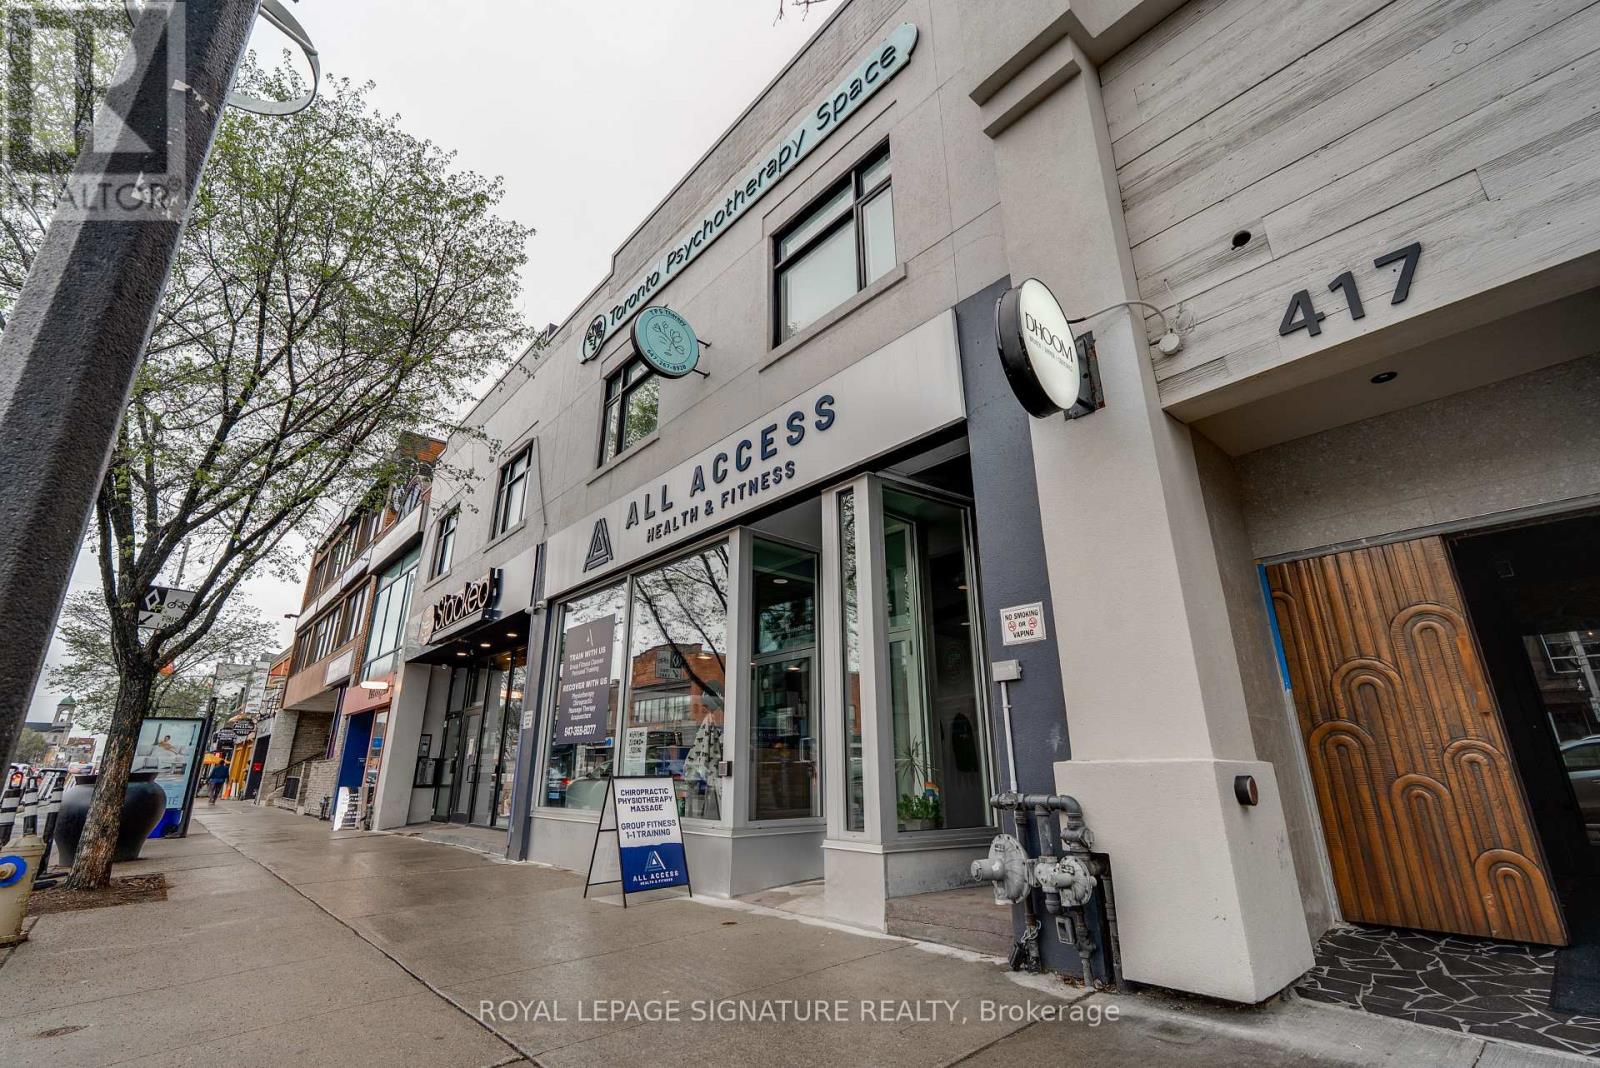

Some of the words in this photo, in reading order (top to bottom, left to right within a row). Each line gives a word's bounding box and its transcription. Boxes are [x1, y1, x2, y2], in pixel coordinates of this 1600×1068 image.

[609, 271, 660, 326] Toronto
[666, 129, 806, 274] Psychotherapy
[816, 44, 897, 132] Space
[1279, 241, 1422, 337] 417
[1025, 312, 1073, 363] DHOOM
[625, 484, 673, 530] ALL
[690, 394, 836, 498] ACCESS
[647, 505, 699, 543] HEALTH
[704, 499, 714, 516] &
[720, 460, 796, 509] FITNESS
[1004, 613, 1013, 621] NO
[1013, 609, 1039, 620] SMOKING
[1013, 629, 1034, 638] VAPING
[584, 649, 598, 659] WITH
[598, 646, 606, 655] US
[562, 681, 585, 692] RECOVER
[585, 679, 599, 689] WITH
[620, 788, 669, 796] CHIROPRACTIC
[617, 796, 673, 804] PHYSIOTHERAPY
[630, 804, 663, 812] MASSAGE
[620, 821, 645, 830] GROUP
[647, 819, 677, 829] FITNESS
[637, 829, 671, 838] TRAINING
[650, 870, 679, 879] ACCESS
